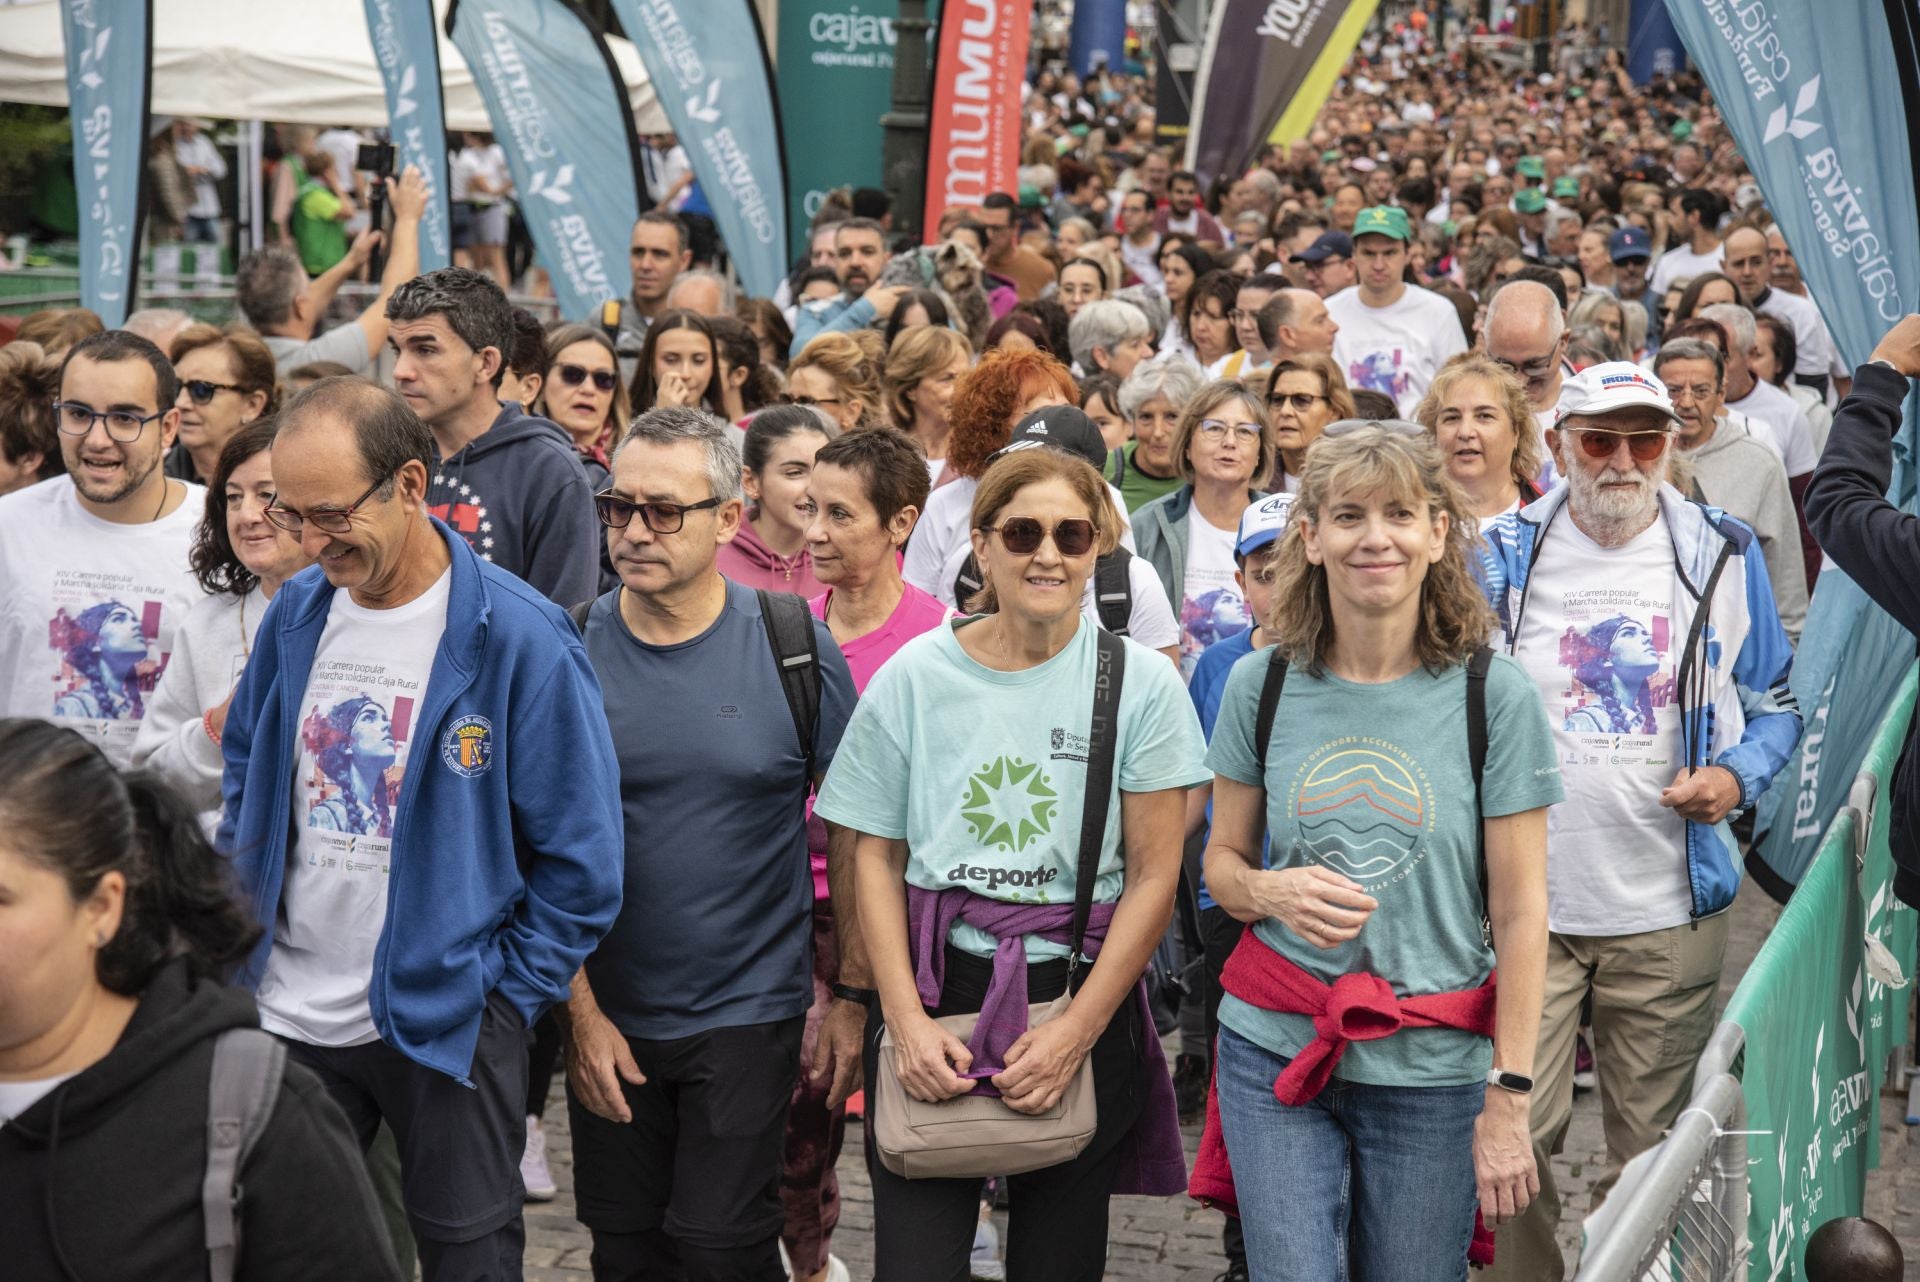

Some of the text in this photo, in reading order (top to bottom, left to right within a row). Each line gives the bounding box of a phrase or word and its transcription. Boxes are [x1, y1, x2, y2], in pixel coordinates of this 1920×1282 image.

[60, 579, 91, 588] Marcha
[72, 570, 101, 580] Carrera
[102, 572, 134, 583] popular
[1609, 589, 1640, 598] popular
[1568, 598, 1598, 606] Marcha
[1599, 597, 1632, 605] solidaria
[1633, 598, 1651, 609] Caja
[1652, 600, 1671, 610] Rural
[327, 661, 354, 672] Carrera
[354, 664, 385, 674] popular
[319, 671, 343, 680] Marcha
[345, 671, 376, 684] solidaria
[377, 675, 396, 688] Caja
[397, 678, 419, 690] Rural
[1791, 675, 1836, 845] rural
[1310, 736, 1358, 761] OUTDOORS
[1362, 737, 1415, 766] ACCESSIBLE
[1416, 766, 1426, 780] TO
[1424, 782, 1437, 833] EVERYONE
[1391, 847, 1427, 884] COMPANY
[947, 863, 1058, 890] deporte
